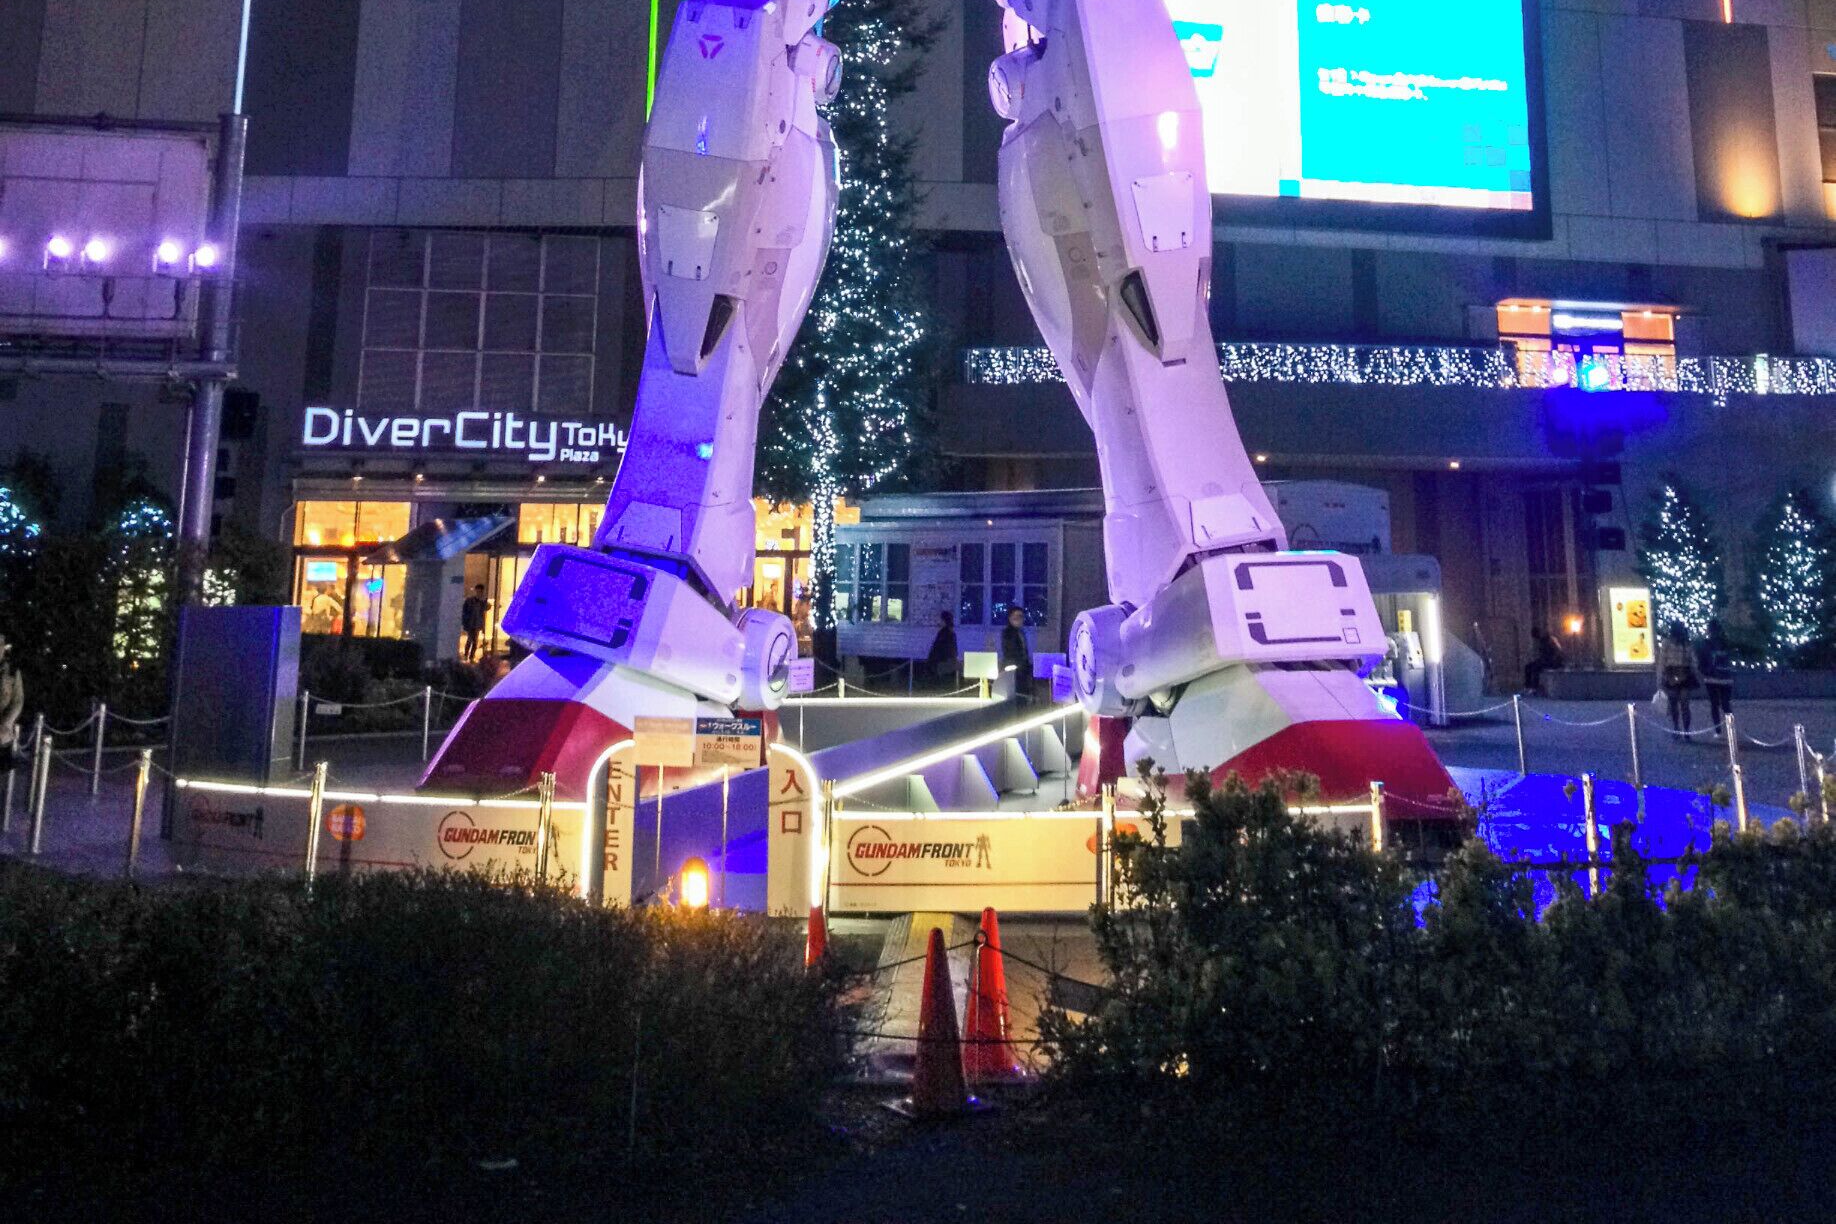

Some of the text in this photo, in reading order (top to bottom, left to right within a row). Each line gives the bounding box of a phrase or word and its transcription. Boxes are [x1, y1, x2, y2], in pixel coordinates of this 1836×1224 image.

[302, 406, 558, 462] DiverCity
[560, 448, 600, 462] Plaza
[944, 859, 972, 867] TOKYO
